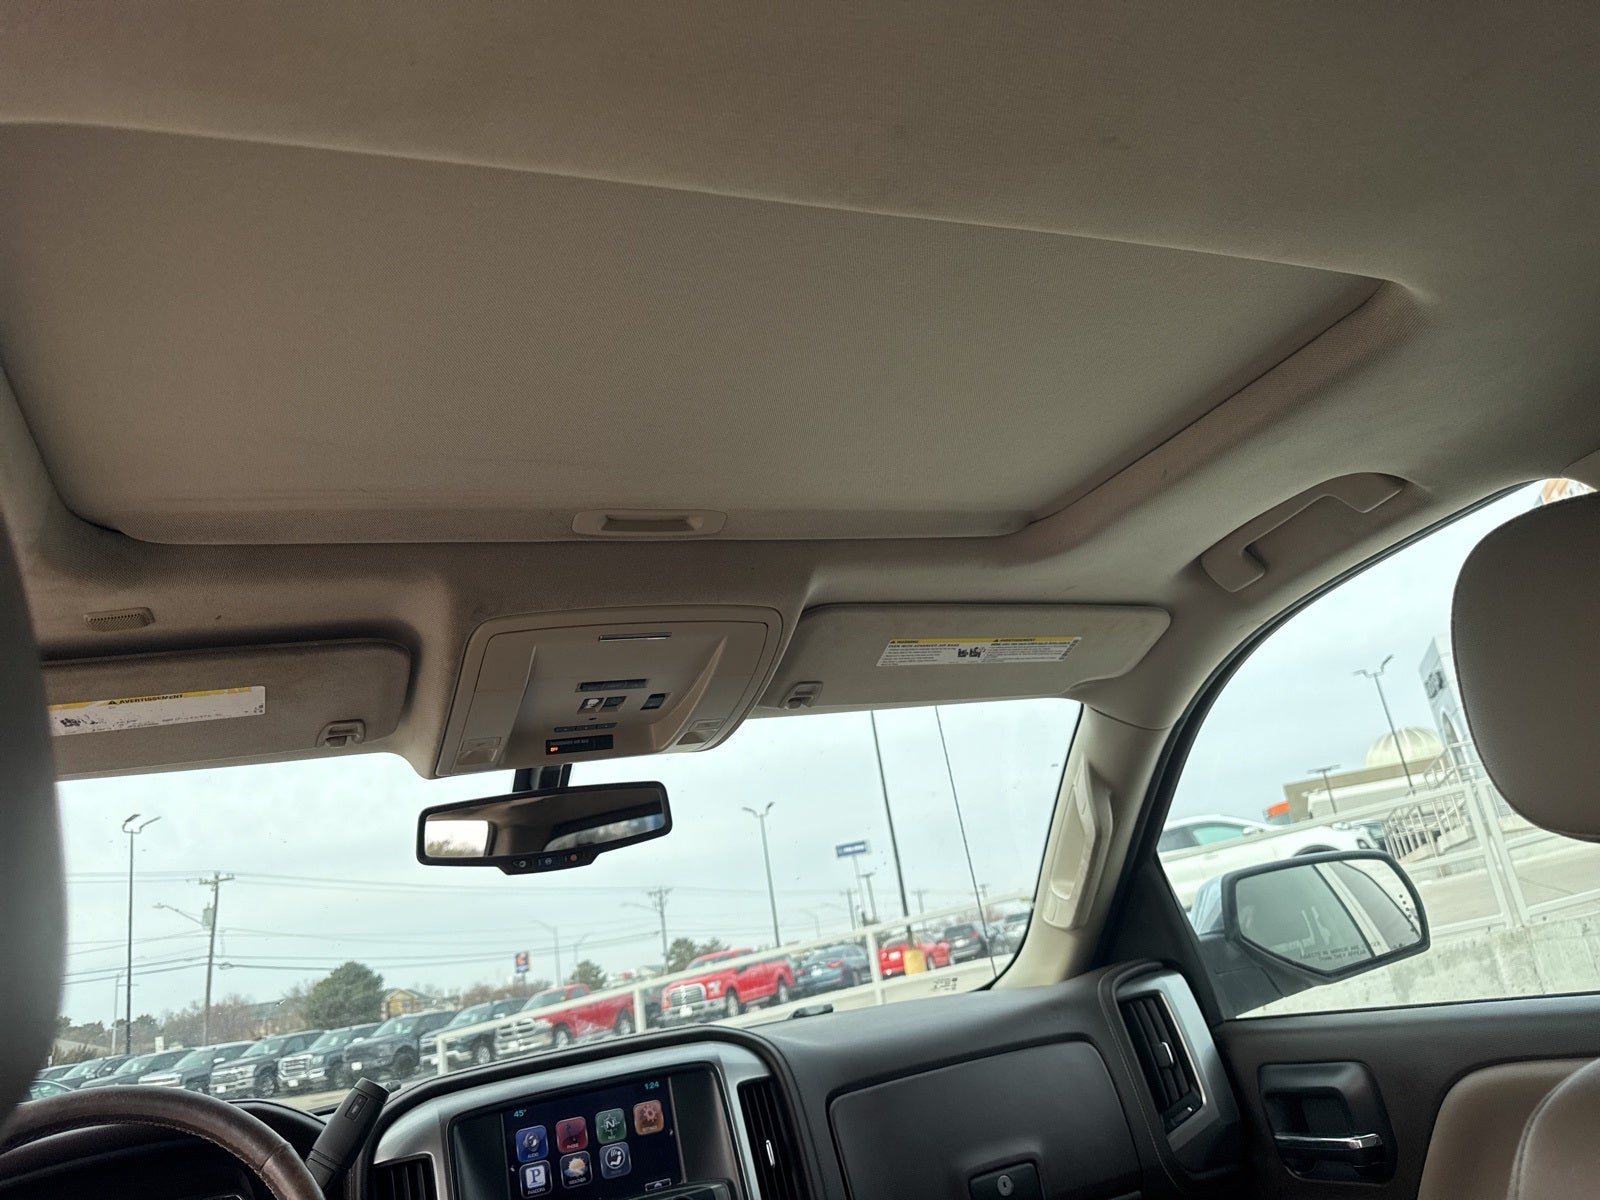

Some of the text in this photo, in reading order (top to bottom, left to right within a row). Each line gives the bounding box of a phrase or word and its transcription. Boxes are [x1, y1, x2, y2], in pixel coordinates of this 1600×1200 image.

[119, 693, 183, 704] AVERTISSEMENT
[644, 1081, 660, 1090] 1:24
[606, 1119, 616, 1129] N
[529, 1168, 541, 1184] P
